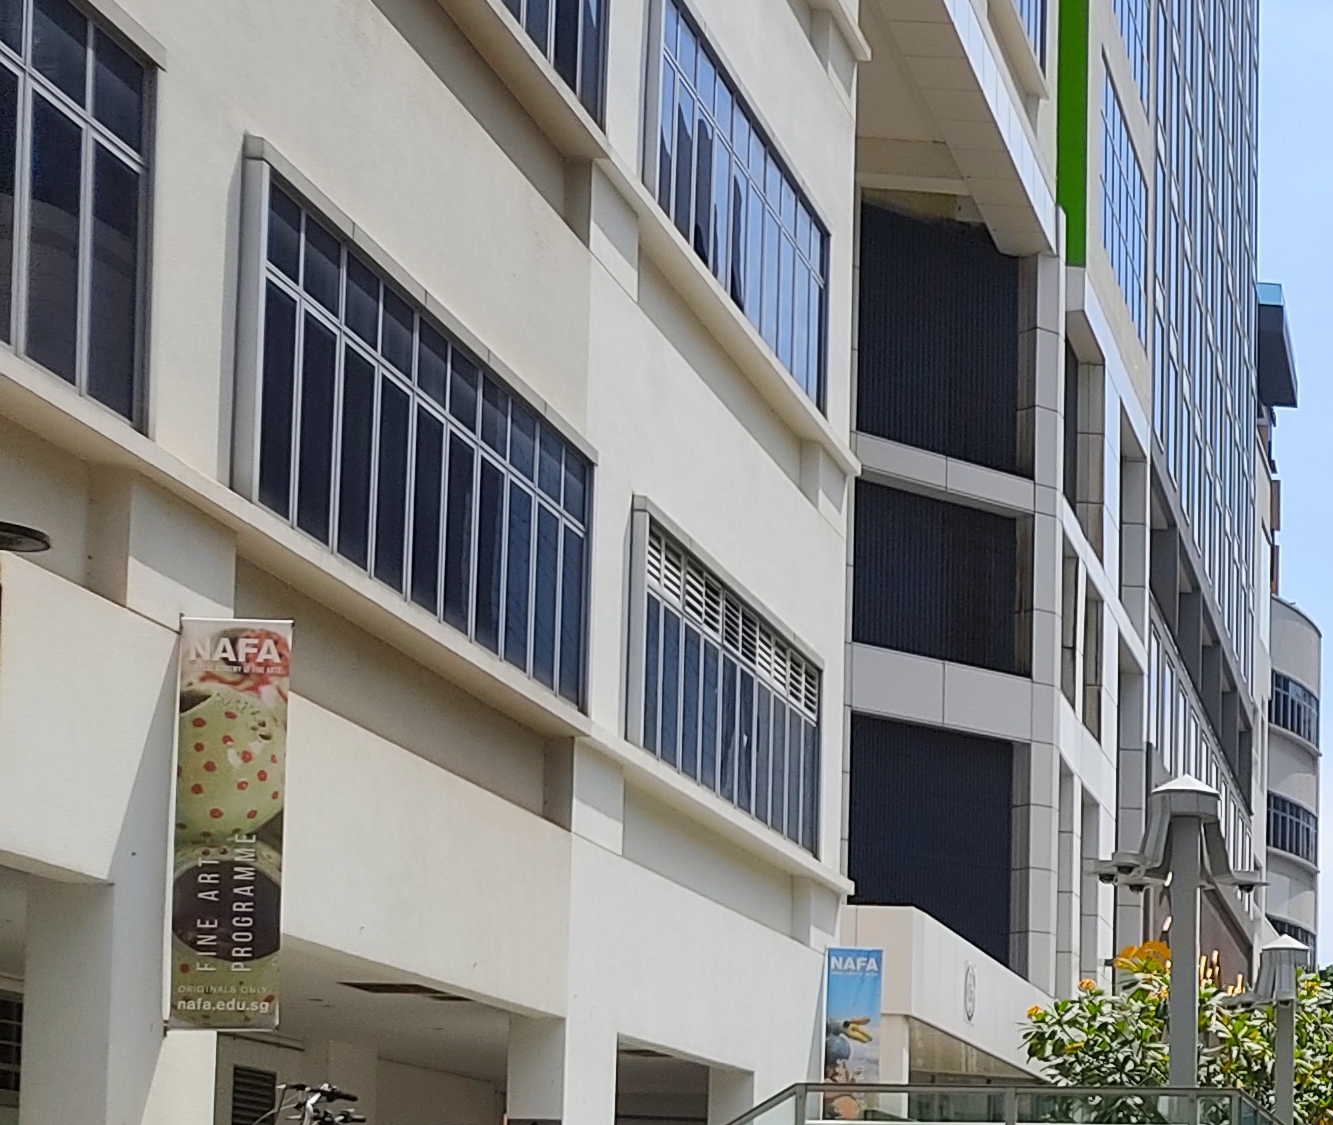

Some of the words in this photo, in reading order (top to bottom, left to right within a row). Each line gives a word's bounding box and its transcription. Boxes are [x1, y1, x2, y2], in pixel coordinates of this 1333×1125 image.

[189, 637, 282, 663] NAFA
[197, 856, 220, 902] ART
[230, 833, 256, 972] PROGRAMME
[196, 918, 218, 972] FINE
[830, 956, 878, 972] NAFA
[178, 984, 236, 994] ORIGINALS
[240, 986, 268, 994] ONLY
[176, 998, 270, 1014] nafa.edu.sg
